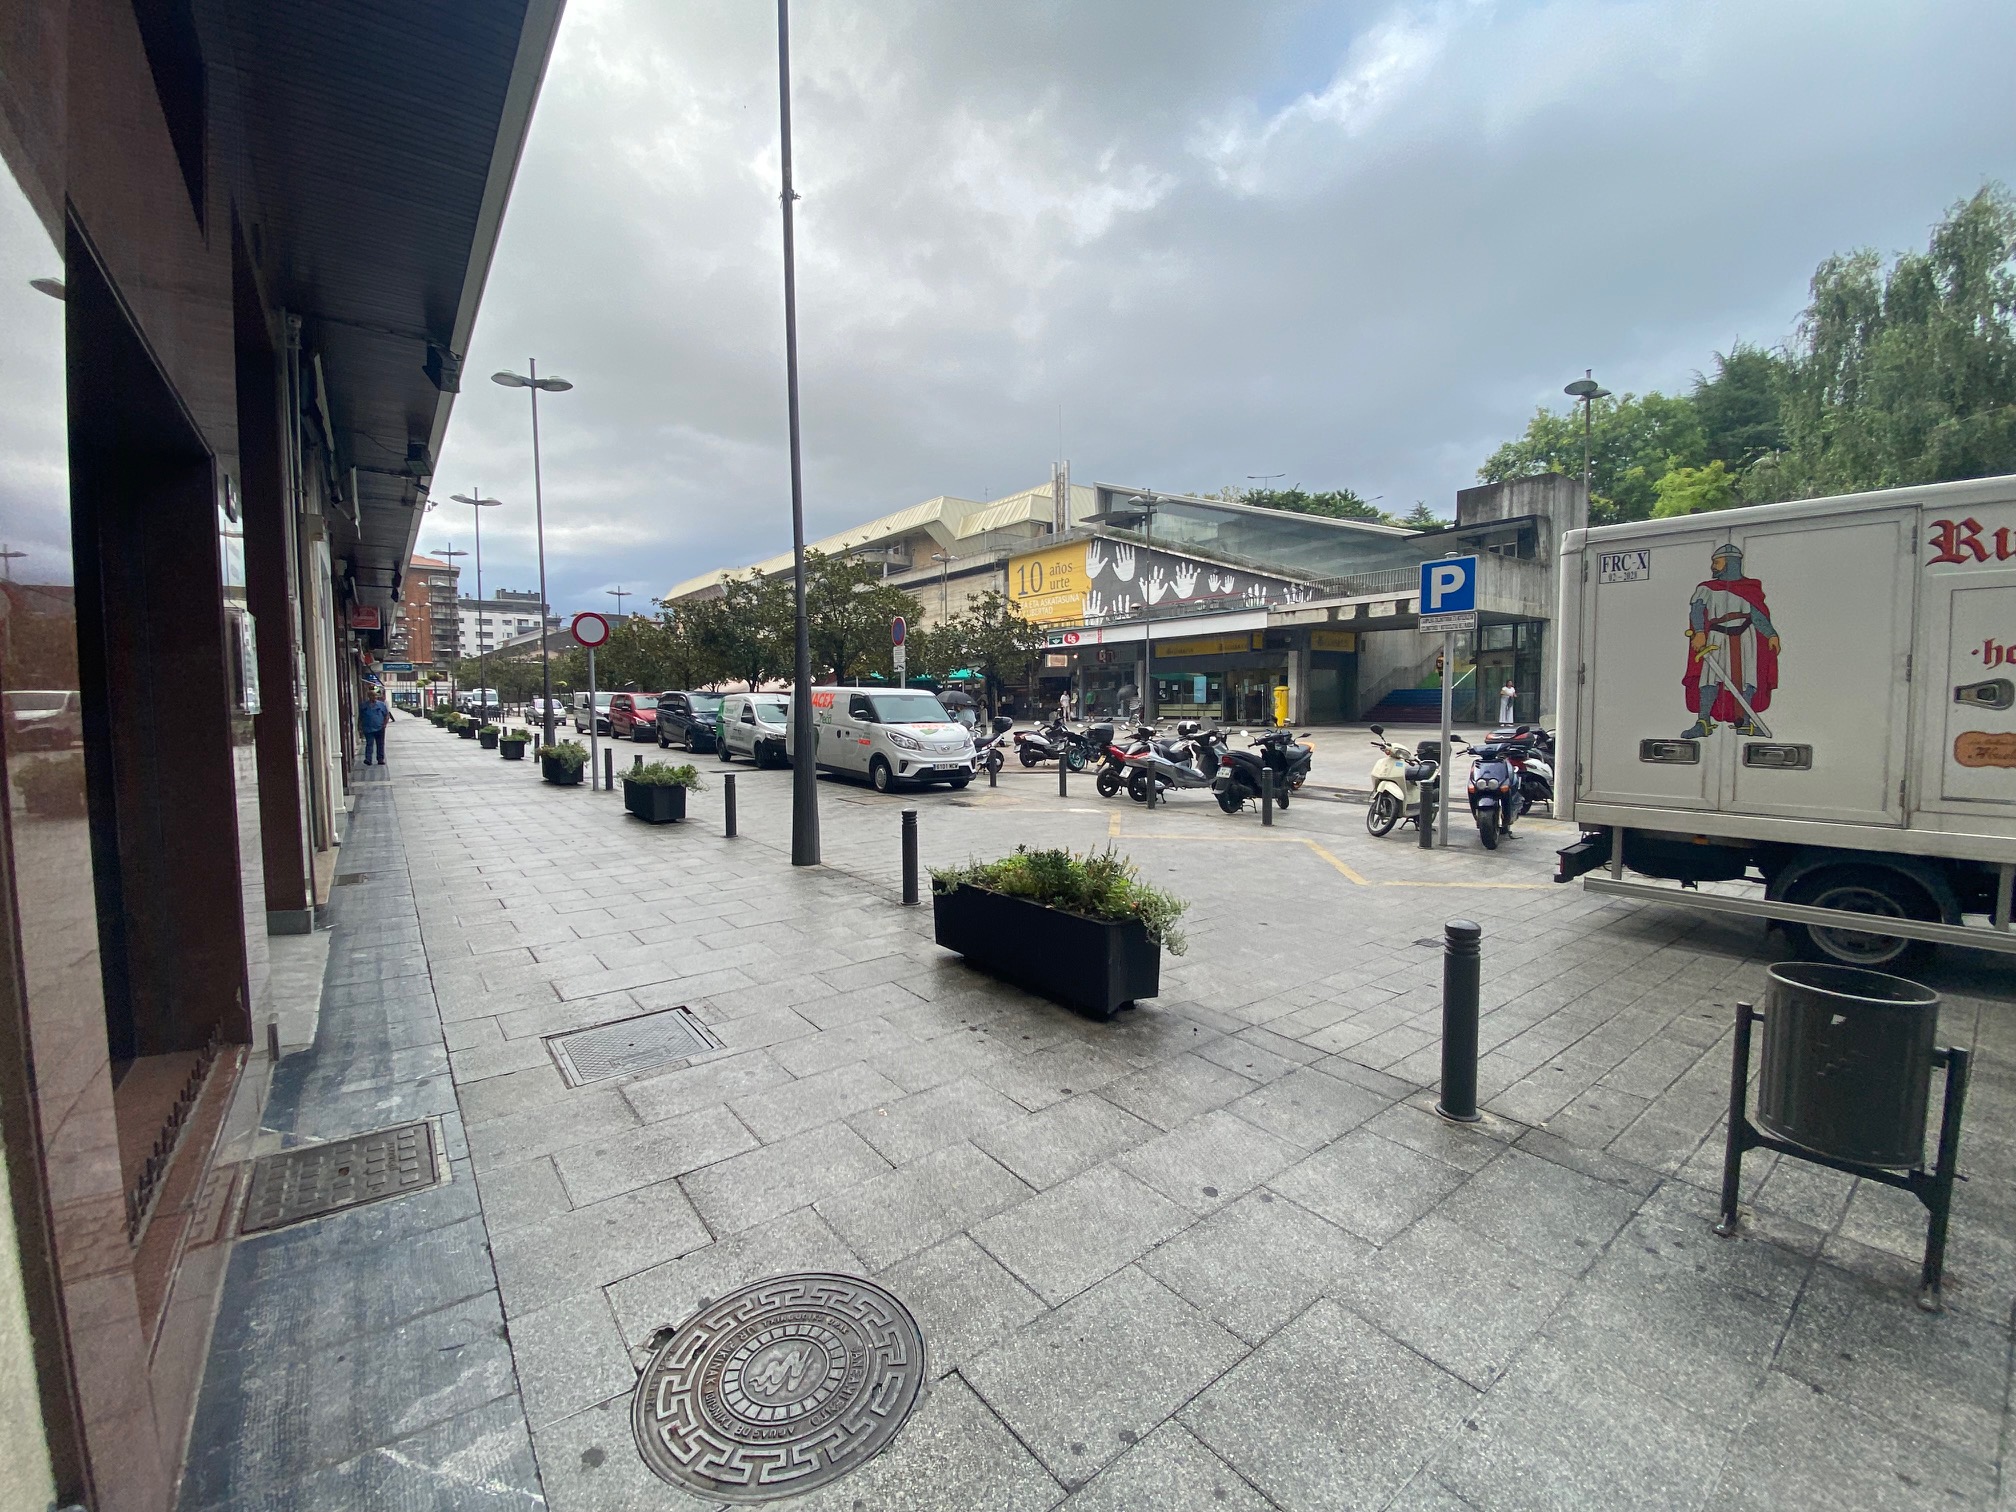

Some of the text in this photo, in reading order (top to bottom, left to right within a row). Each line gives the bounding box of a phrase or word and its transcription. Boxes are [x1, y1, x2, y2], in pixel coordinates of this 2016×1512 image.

[1602, 552, 1648, 573] FRC-X
[1017, 561, 1073, 596] 10 años
[1049, 577, 1070, 590] urte
[1430, 565, 1466, 609] P
[1040, 593, 1080, 607] ASKATASUNA
[810, 692, 835, 708] ACEX
[737, 1326, 758, 1341] UR
[734, 1424, 751, 1438] DE
[752, 1425, 796, 1440] AGUAS
